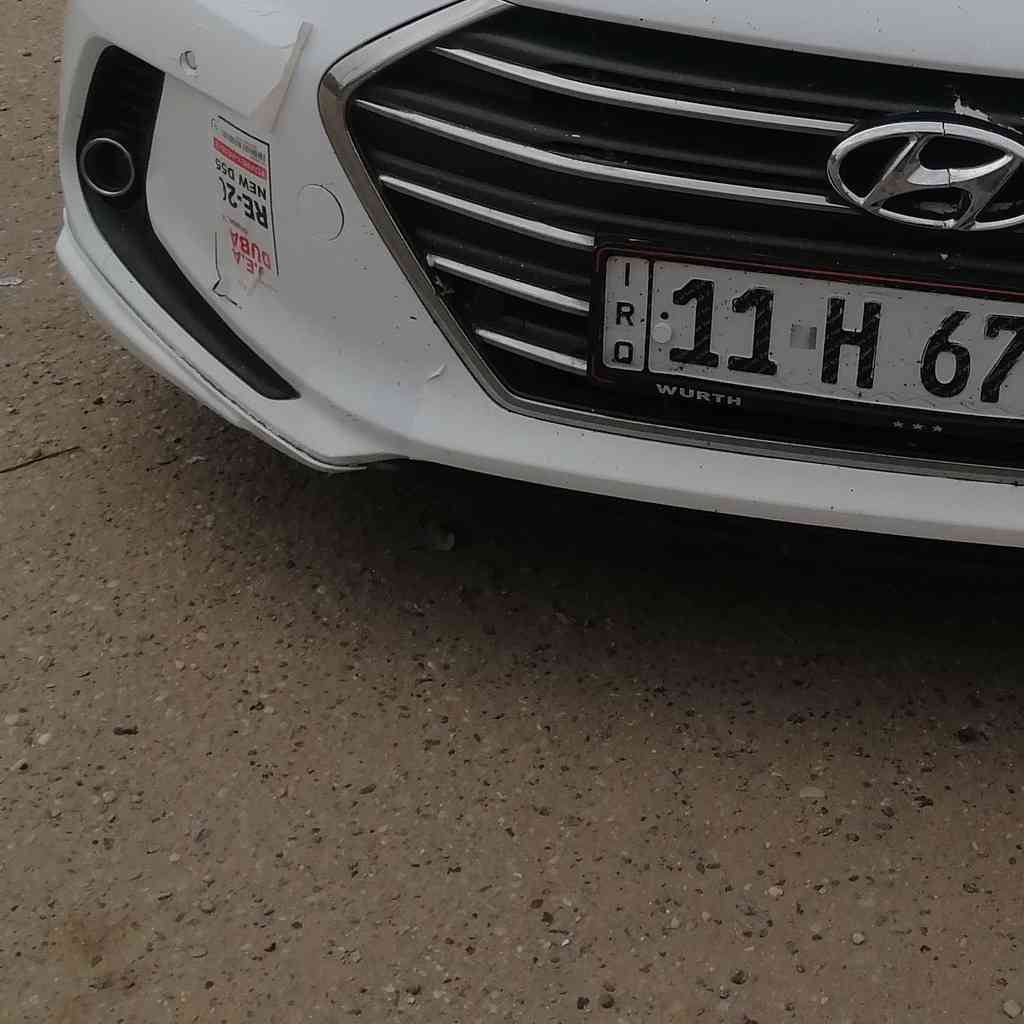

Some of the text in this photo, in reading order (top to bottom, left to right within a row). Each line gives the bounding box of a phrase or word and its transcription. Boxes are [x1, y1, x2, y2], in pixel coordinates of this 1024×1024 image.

[239, 174, 267, 201] NEW
[669, 278, 778, 375] 11
[821, 297, 882, 389] H
[655, 383, 742, 406] WURTH
